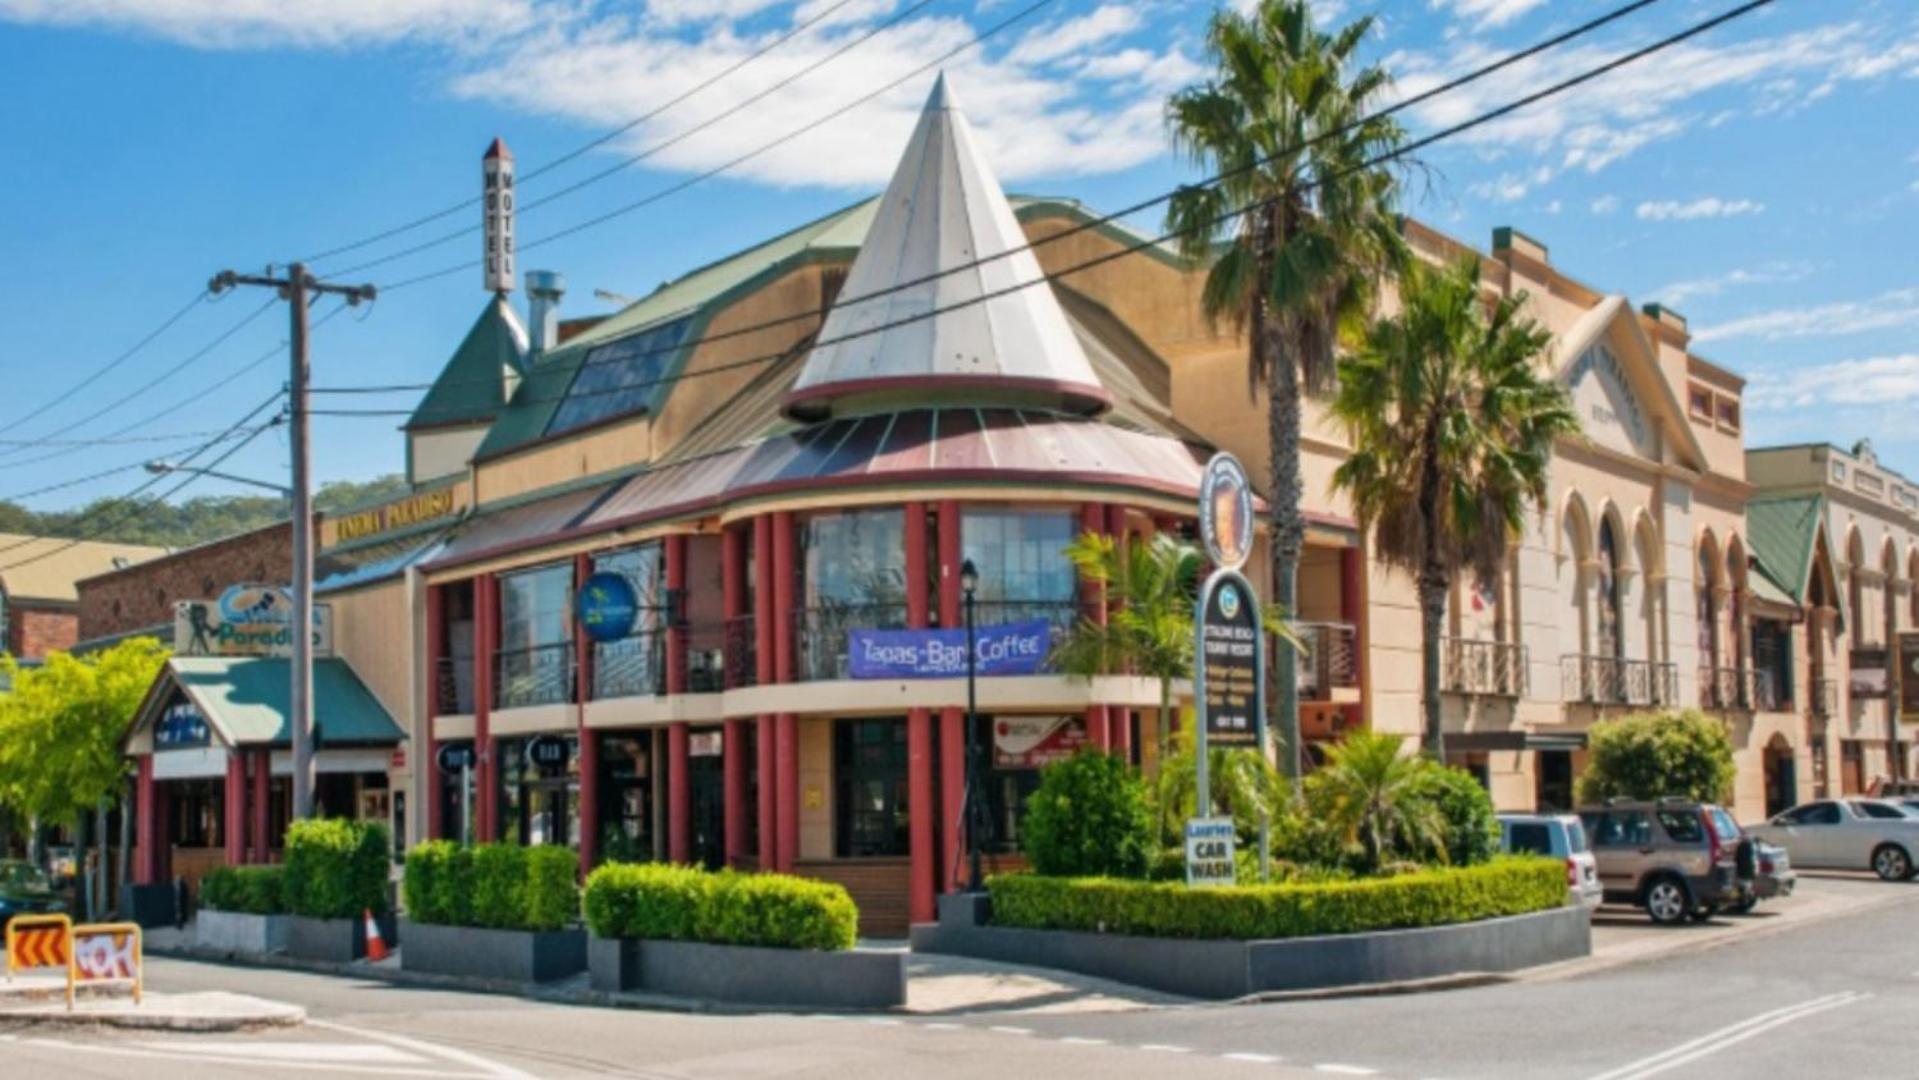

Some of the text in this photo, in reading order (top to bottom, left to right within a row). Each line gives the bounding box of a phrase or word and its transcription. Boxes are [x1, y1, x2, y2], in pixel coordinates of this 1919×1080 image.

[486, 172, 498, 275] MOTEL
[502, 172, 513, 275] MOTEL
[388, 486, 454, 528] PARADISO
[1188, 860, 1233, 879] WASH
[1195, 841, 1227, 860] CAR
